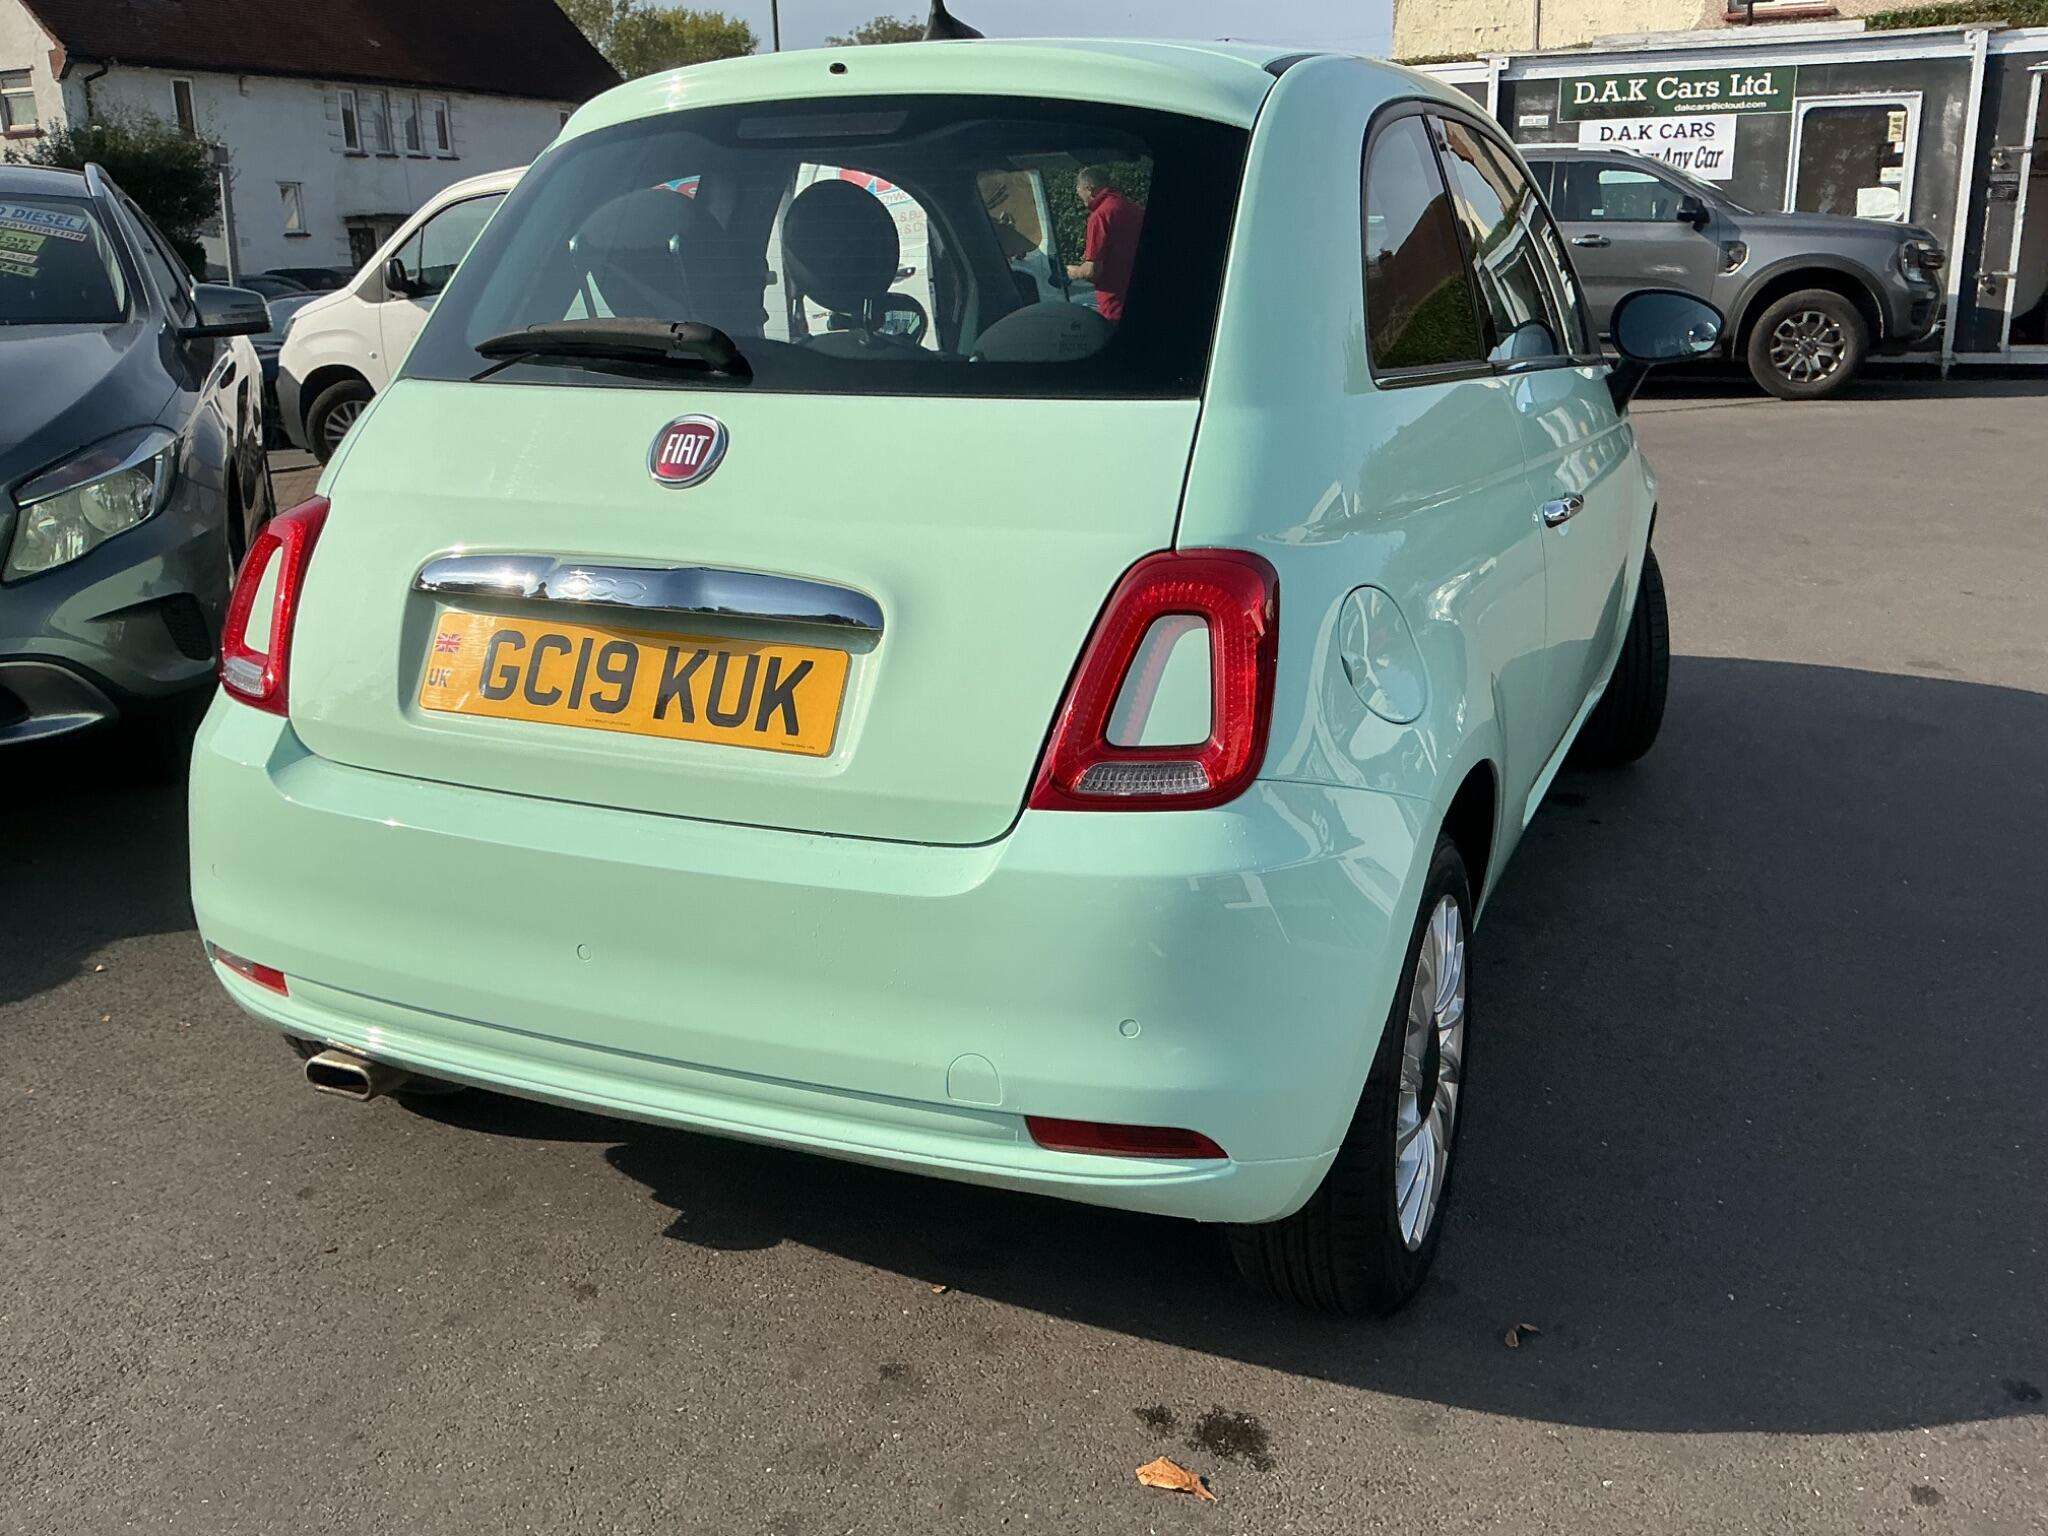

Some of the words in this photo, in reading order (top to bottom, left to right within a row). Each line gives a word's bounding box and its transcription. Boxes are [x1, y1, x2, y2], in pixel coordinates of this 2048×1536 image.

[1574, 78, 1648, 104] D.A.K
[1656, 76, 1720, 100] Cars
[1729, 72, 1779, 97] Ltd.
[1674, 101, 1767, 112] dakcars@icloud.com
[1600, 124, 1652, 142] D.A.K
[1659, 121, 1716, 139] CARS
[1663, 147, 1693, 169] Any
[1695, 145, 1724, 169] Car
[12, 208, 75, 228] DIESEL
[660, 433, 711, 466] FIAT
[428, 667, 451, 688] UK
[479, 629, 640, 714] GC19
[652, 646, 815, 737] KUK
